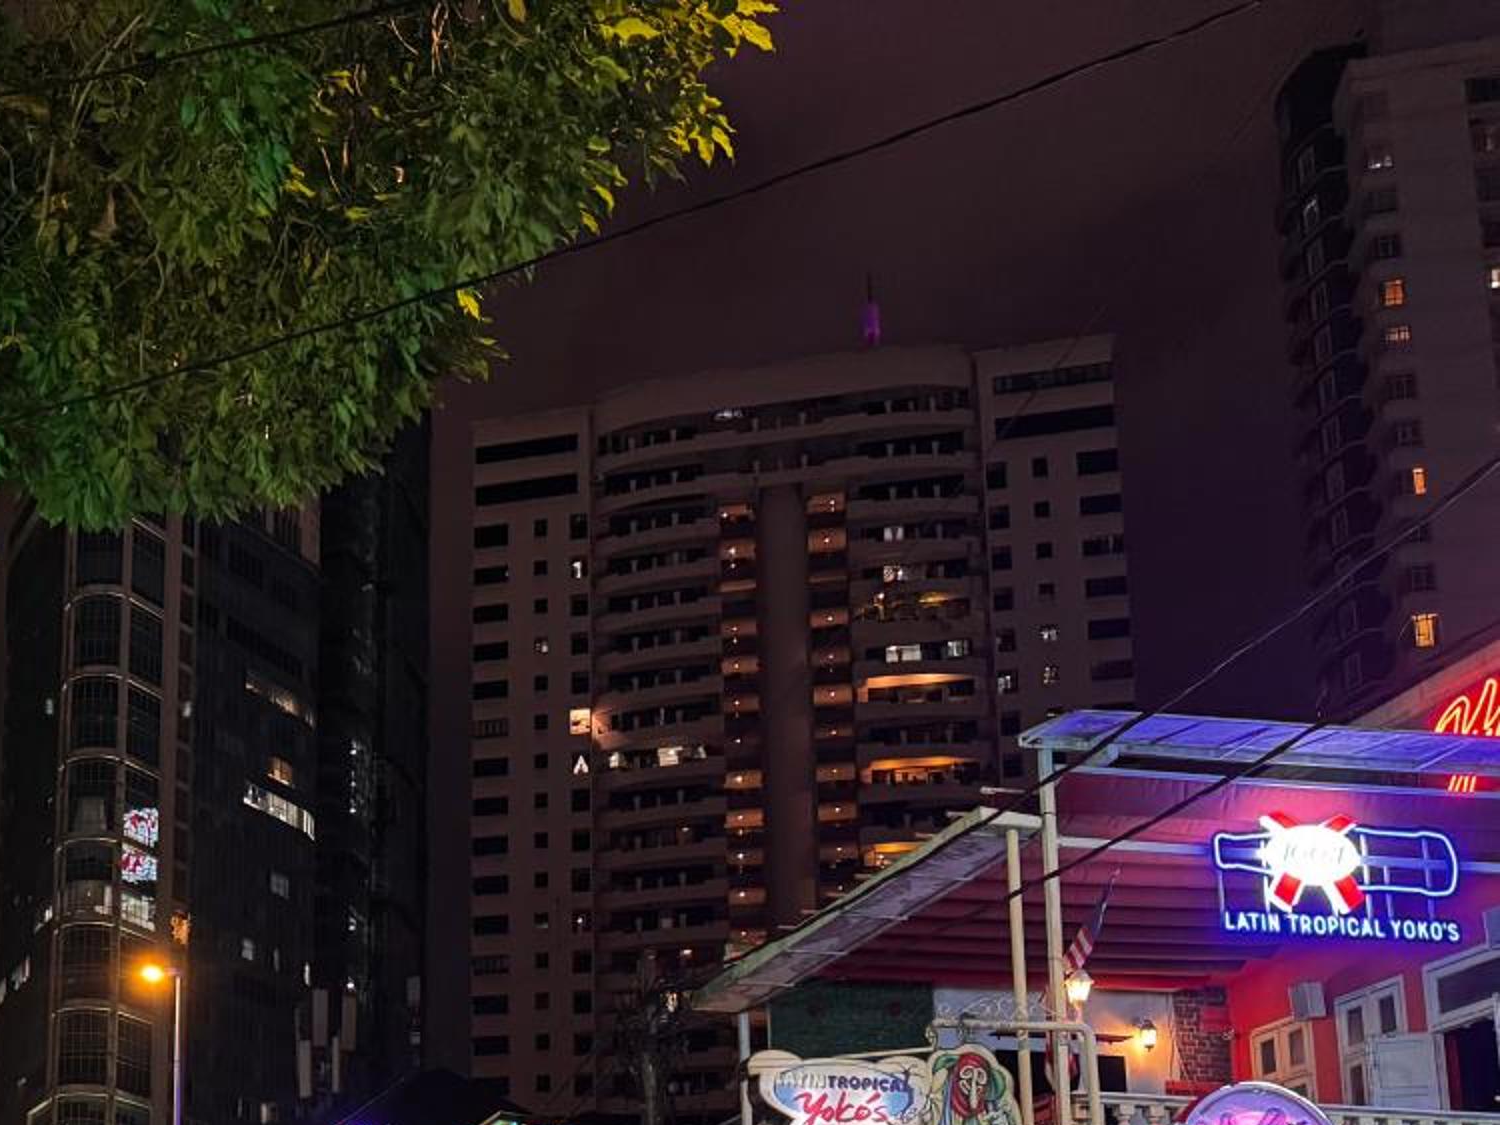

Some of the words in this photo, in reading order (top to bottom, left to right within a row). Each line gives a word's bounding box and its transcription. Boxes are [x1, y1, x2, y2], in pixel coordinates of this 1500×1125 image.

[1223, 910, 1281, 933] LATIN
[1288, 913, 1386, 939] TROPICAL
[1390, 918, 1461, 942] YOKO'S
[827, 1074, 909, 1093] TROPICAL
